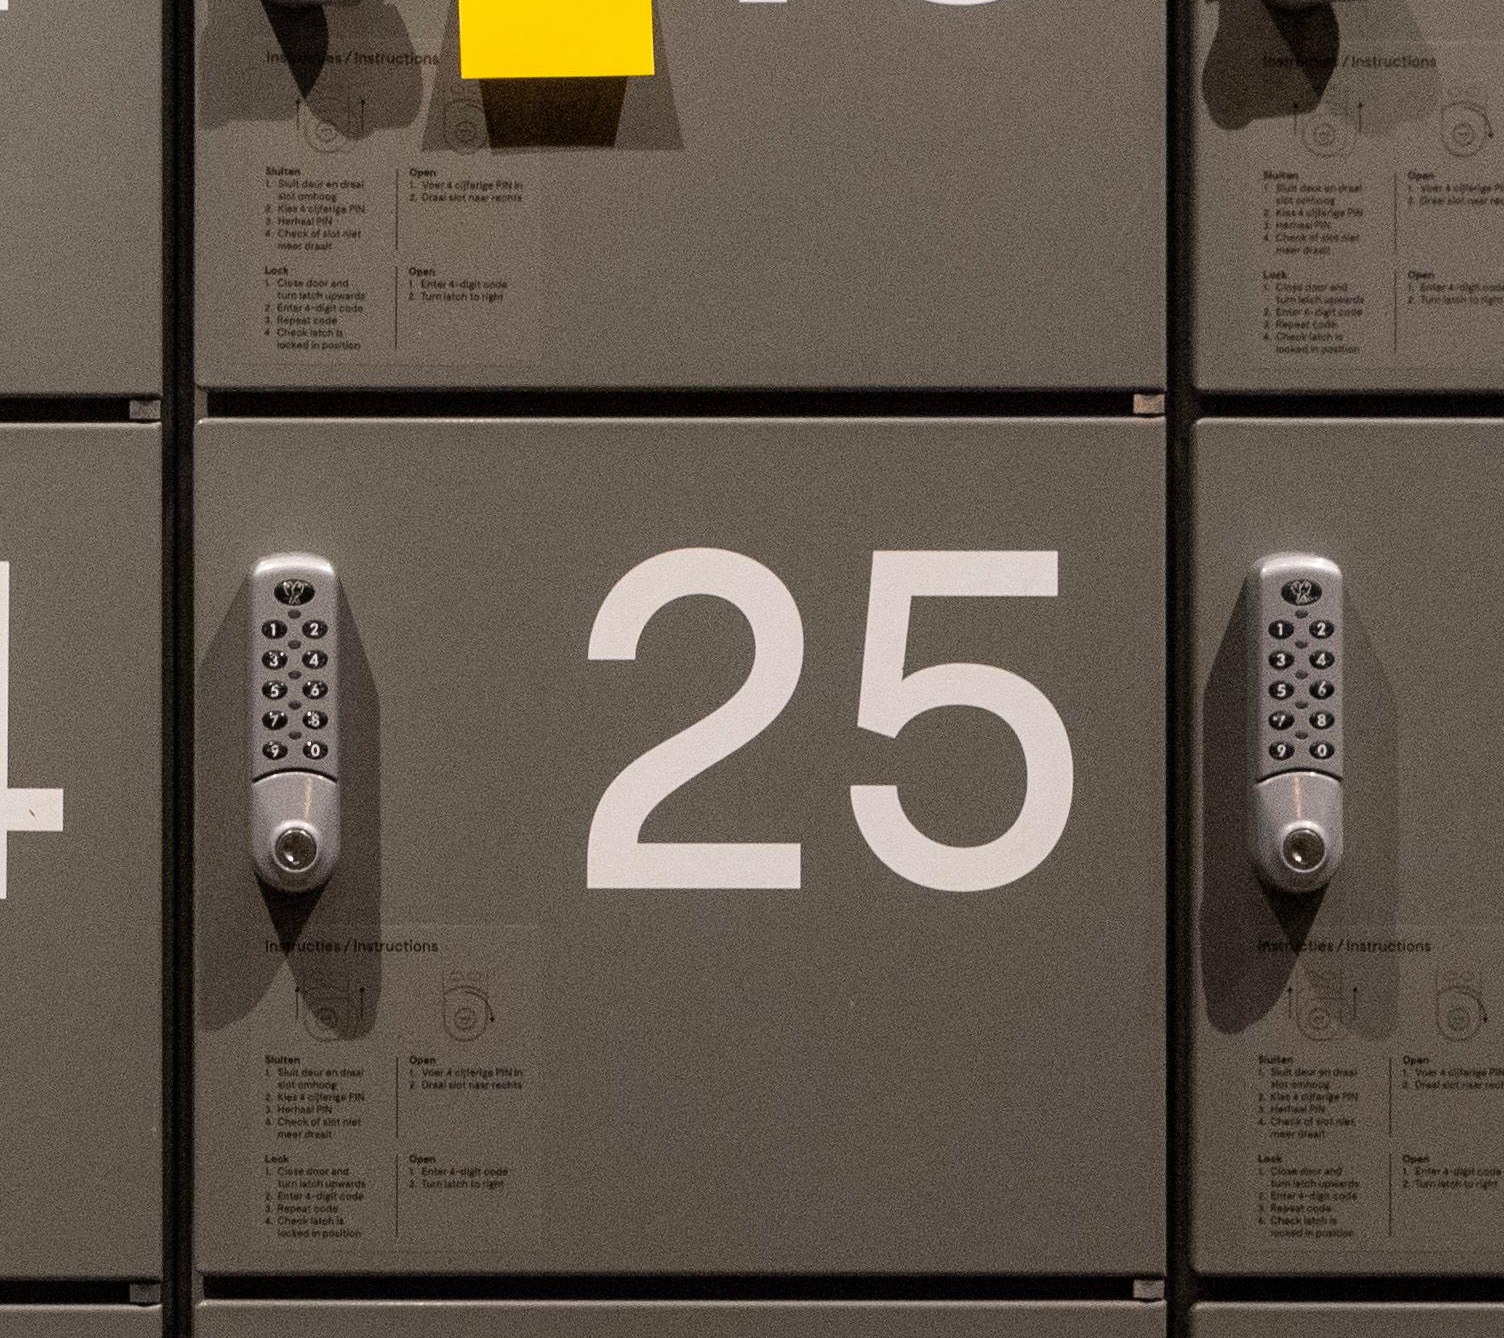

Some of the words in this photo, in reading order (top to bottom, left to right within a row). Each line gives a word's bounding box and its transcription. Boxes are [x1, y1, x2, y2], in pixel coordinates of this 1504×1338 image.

[1352, 56, 1437, 68] Instructions
[586, 547, 1074, 893] 25
[354, 940, 439, 952] Instructions
